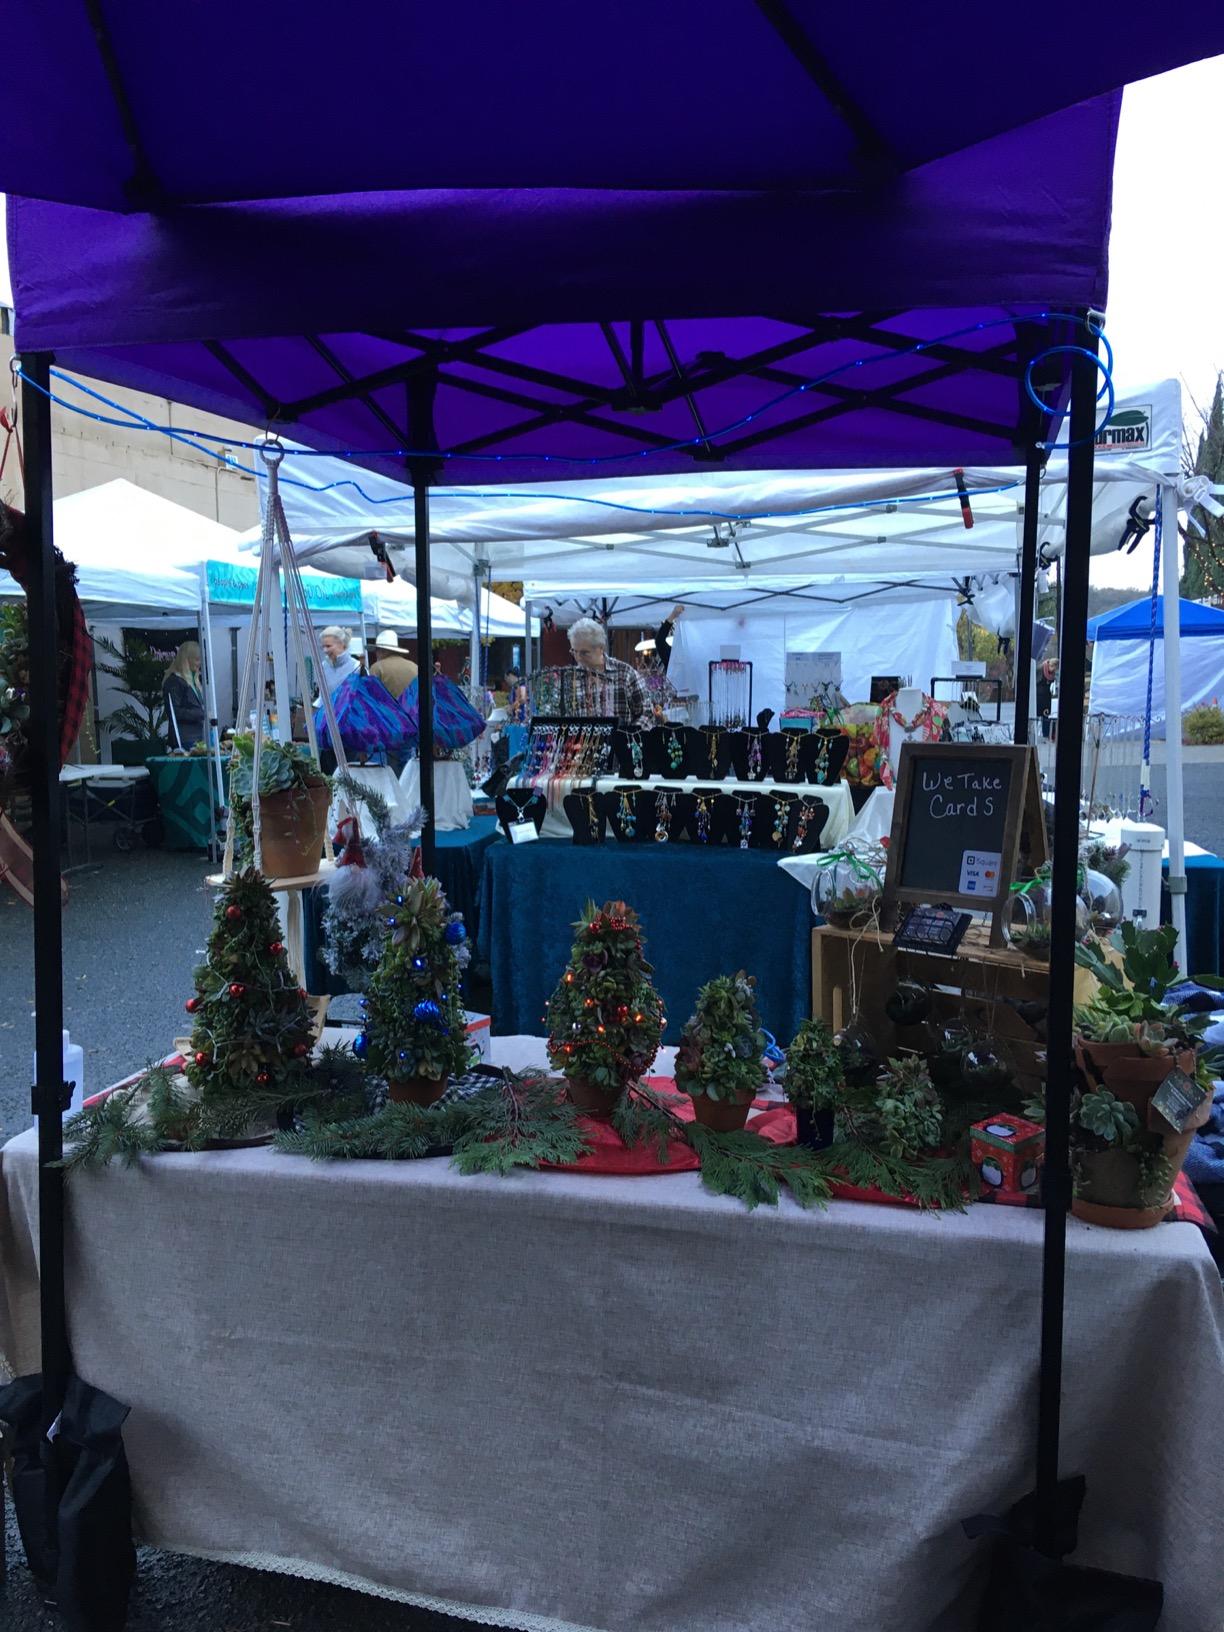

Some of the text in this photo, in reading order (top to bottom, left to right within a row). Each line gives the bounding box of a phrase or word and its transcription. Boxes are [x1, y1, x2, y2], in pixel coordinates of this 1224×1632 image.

[1094, 426, 1145, 445] urmax
[922, 771, 1002, 791] We Take
